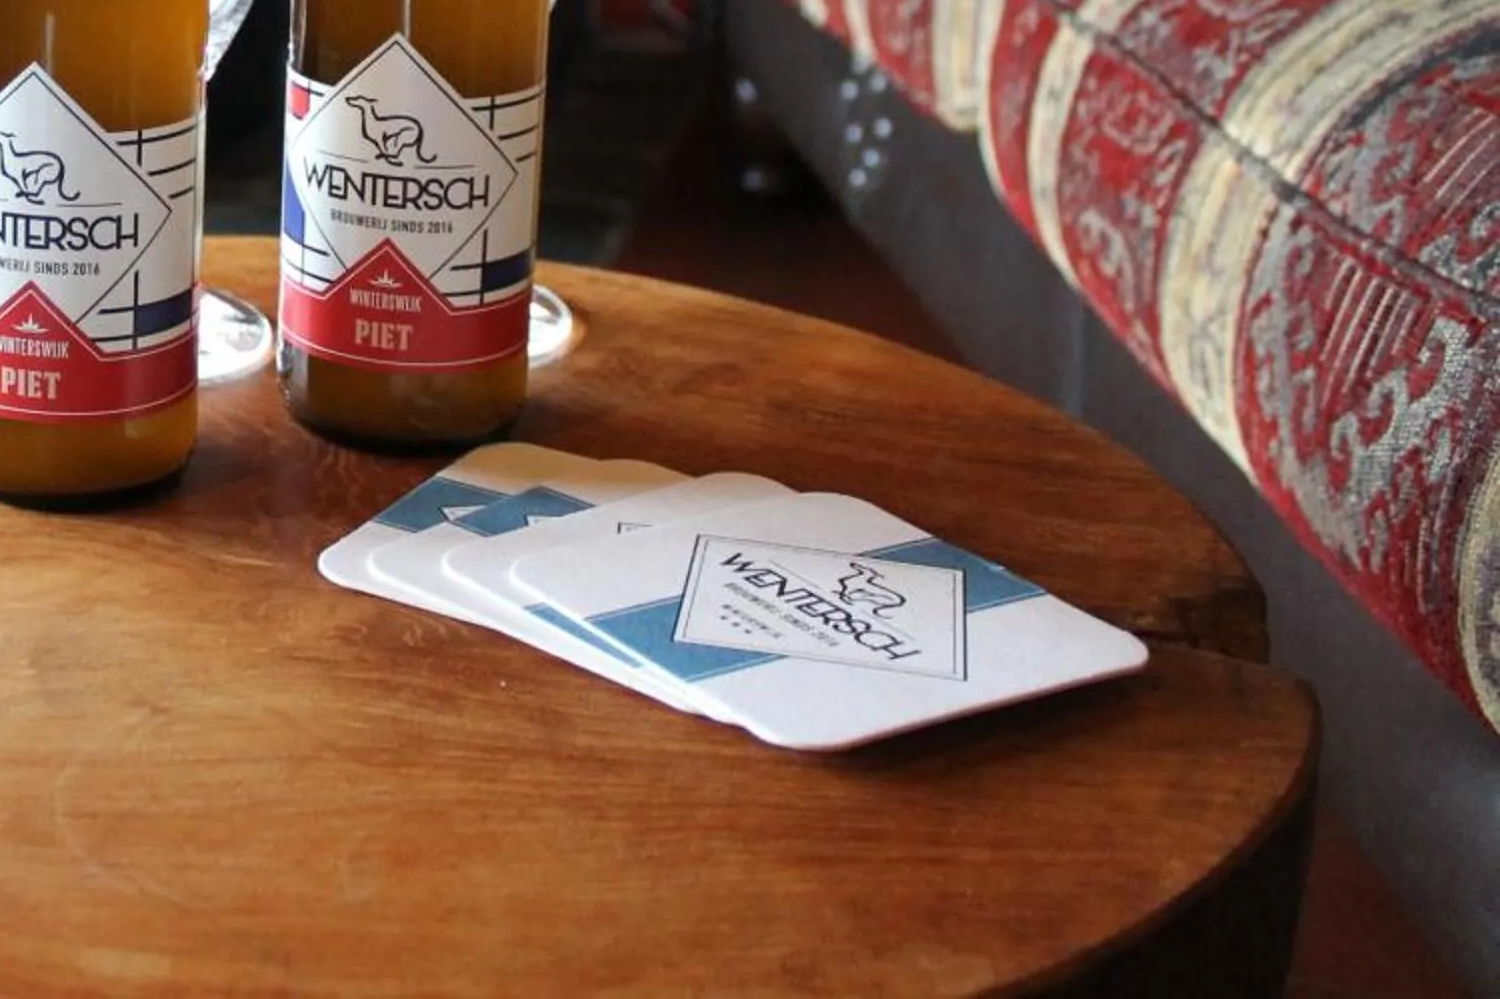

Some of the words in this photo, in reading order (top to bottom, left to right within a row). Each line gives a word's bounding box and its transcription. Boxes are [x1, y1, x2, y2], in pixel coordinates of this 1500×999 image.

[303, 155, 490, 211] WENTERSCH
[33, 259, 69, 276] SINDS
[355, 318, 414, 351] PIET
[1, 365, 61, 400] PIET
[720, 552, 922, 660] WENTERSCH
